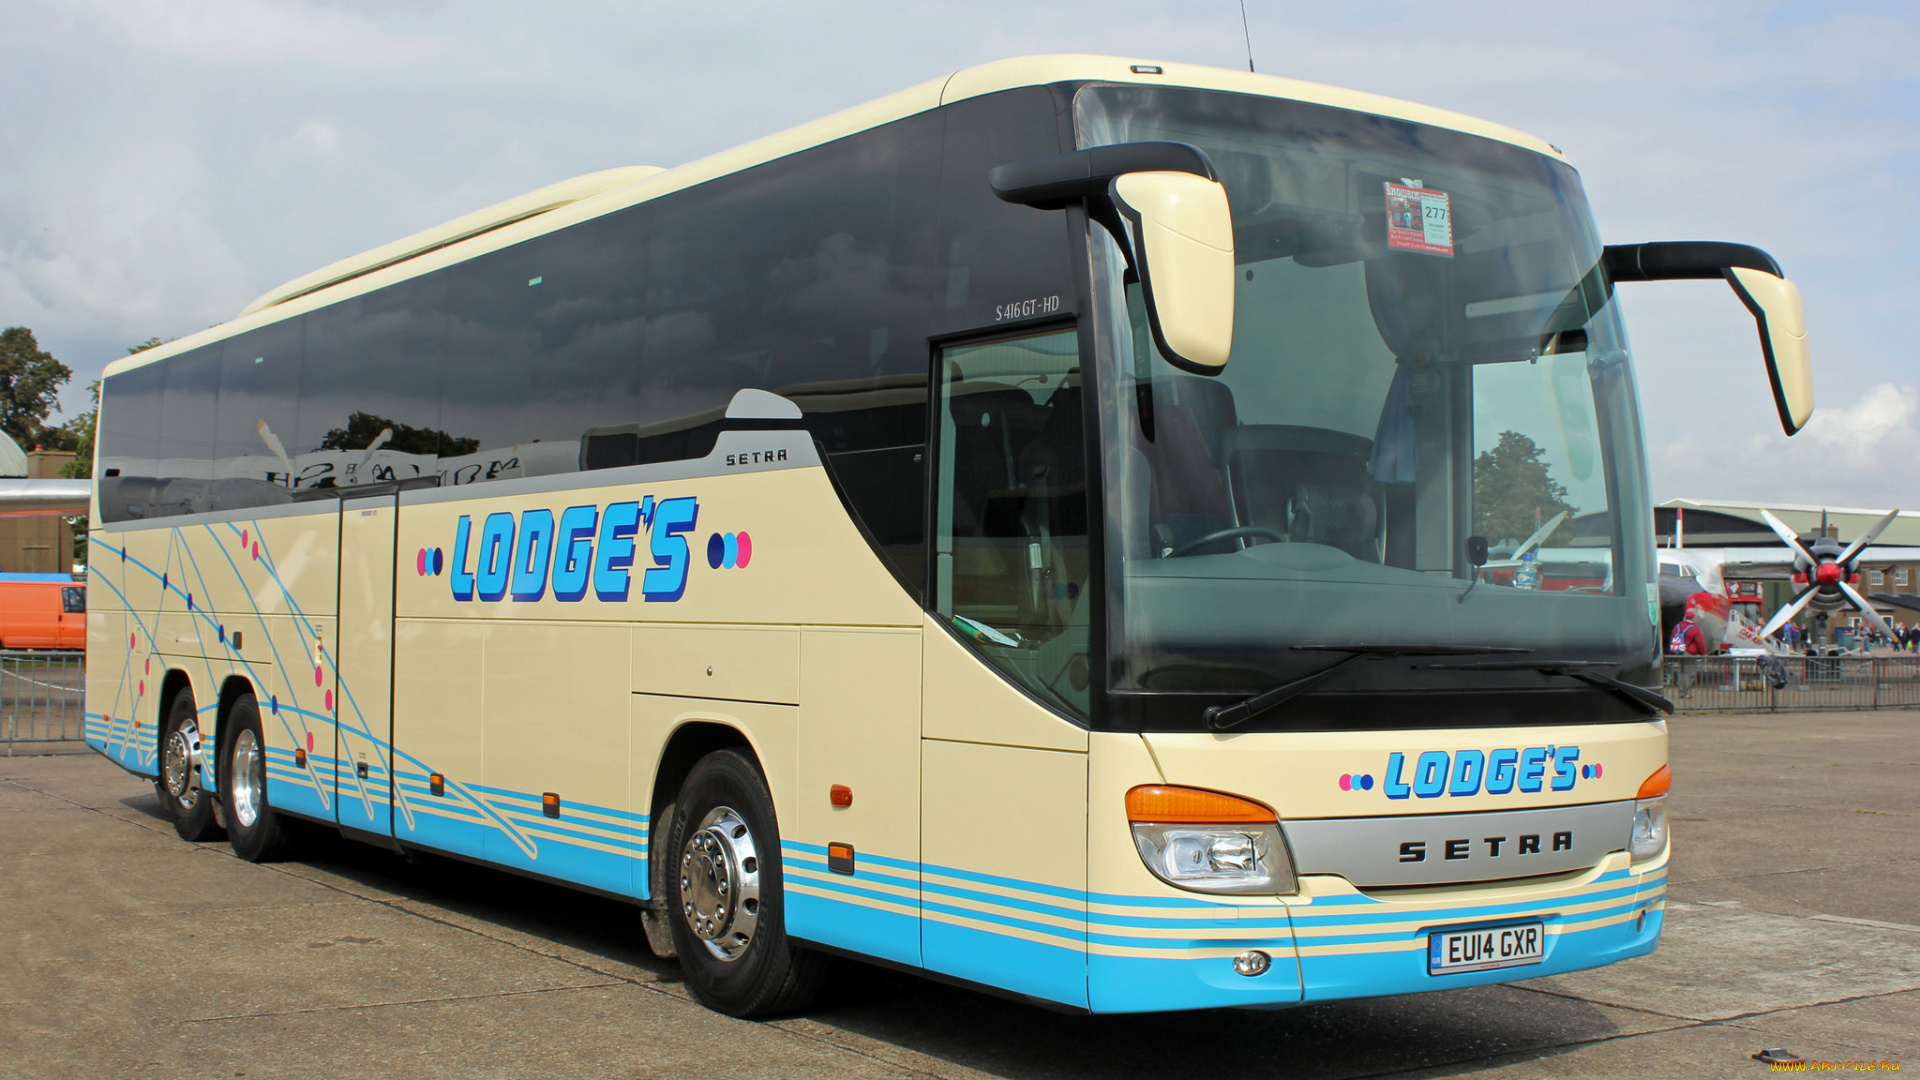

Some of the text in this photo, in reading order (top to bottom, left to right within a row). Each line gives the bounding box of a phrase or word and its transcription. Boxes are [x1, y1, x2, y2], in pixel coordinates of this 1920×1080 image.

[1425, 206, 1446, 220] 277
[996, 305, 1003, 321] S
[1004, 302, 1021, 319] 416
[726, 448, 789, 466] SETRA
[451, 495, 699, 602] LODGE'S
[1383, 745, 1580, 800] LODGE'S
[1399, 831, 1573, 863] SETRA
[1449, 928, 1537, 963] EU14 GXR
